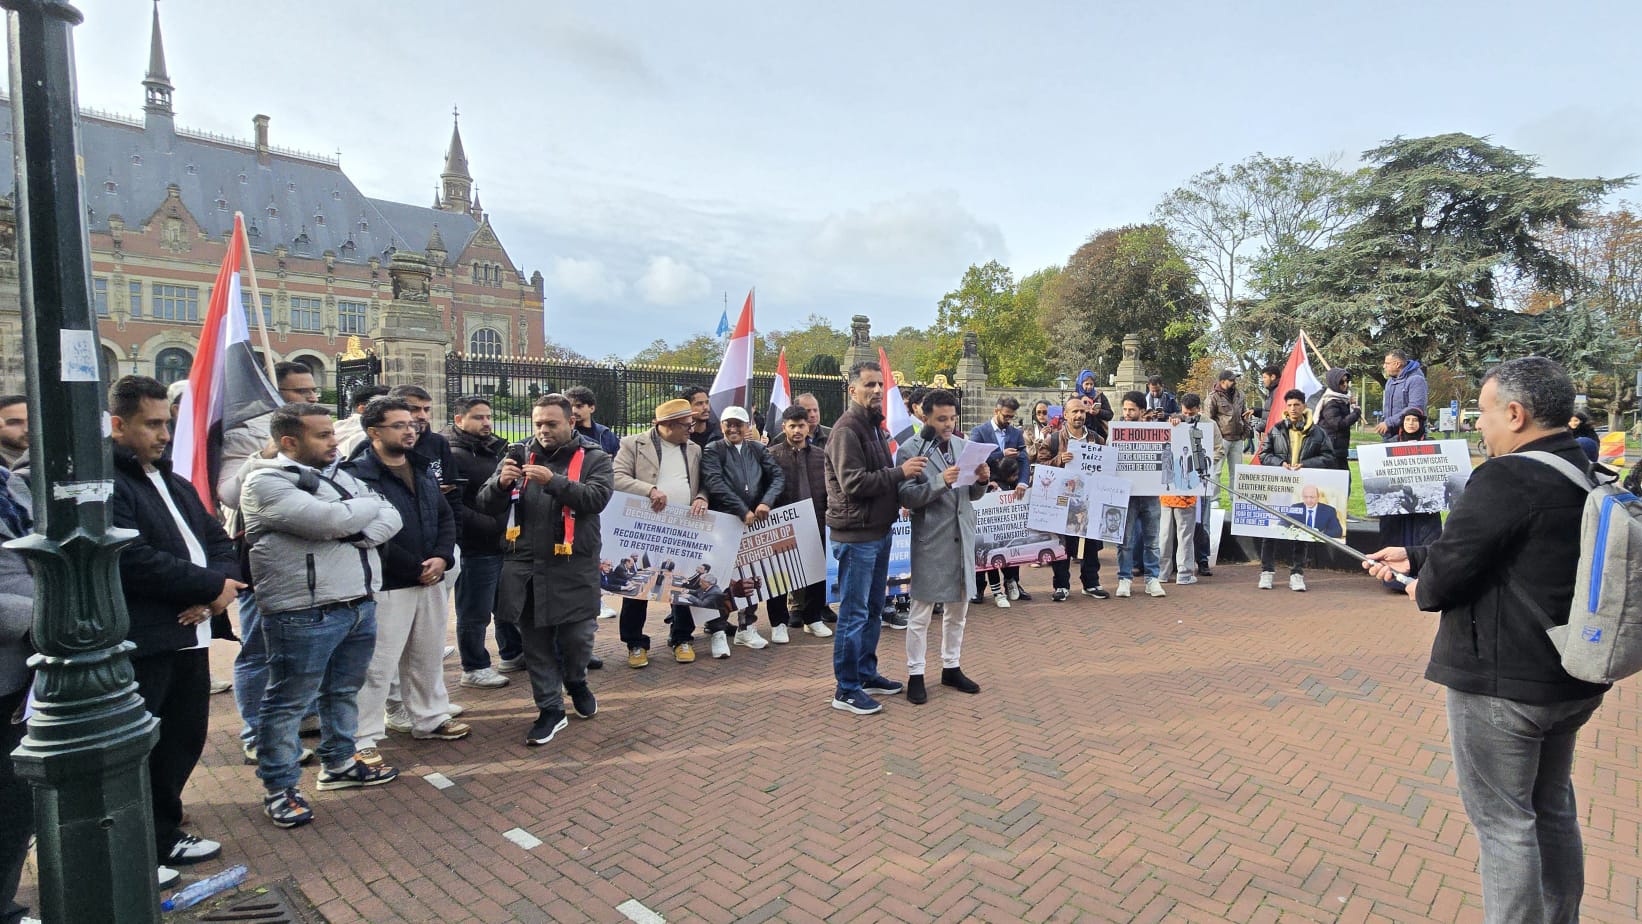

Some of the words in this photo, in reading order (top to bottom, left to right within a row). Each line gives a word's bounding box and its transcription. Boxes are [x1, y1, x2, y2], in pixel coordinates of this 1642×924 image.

[1114, 429, 1126, 440] DE
[1128, 428, 1170, 440] HOUTHI'S
[1081, 462, 1102, 472] Siege
[625, 508, 666, 523] DECISIONS
[667, 516, 678, 524] OF
[982, 506, 1009, 515] ARBITRAIRE
[977, 514, 1010, 525] EDEWERKERS
[633, 521, 699, 540] INTERNATIONALLY
[892, 525, 910, 535] AVIG
[982, 522, 1023, 533] INTERNATIONALE
[613, 528, 660, 543] RECOGNIZED
[662, 536, 713, 552] GOVERNMENT
[755, 529, 779, 545] GEZIN
[780, 526, 791, 538] OP
[619, 539, 629, 548] TO
[630, 541, 664, 554] RESTORE
[666, 546, 680, 556] THE
[681, 548, 703, 560] STATE
[1010, 548, 1020, 557] UN
[737, 546, 773, 566] HTIGHEID
